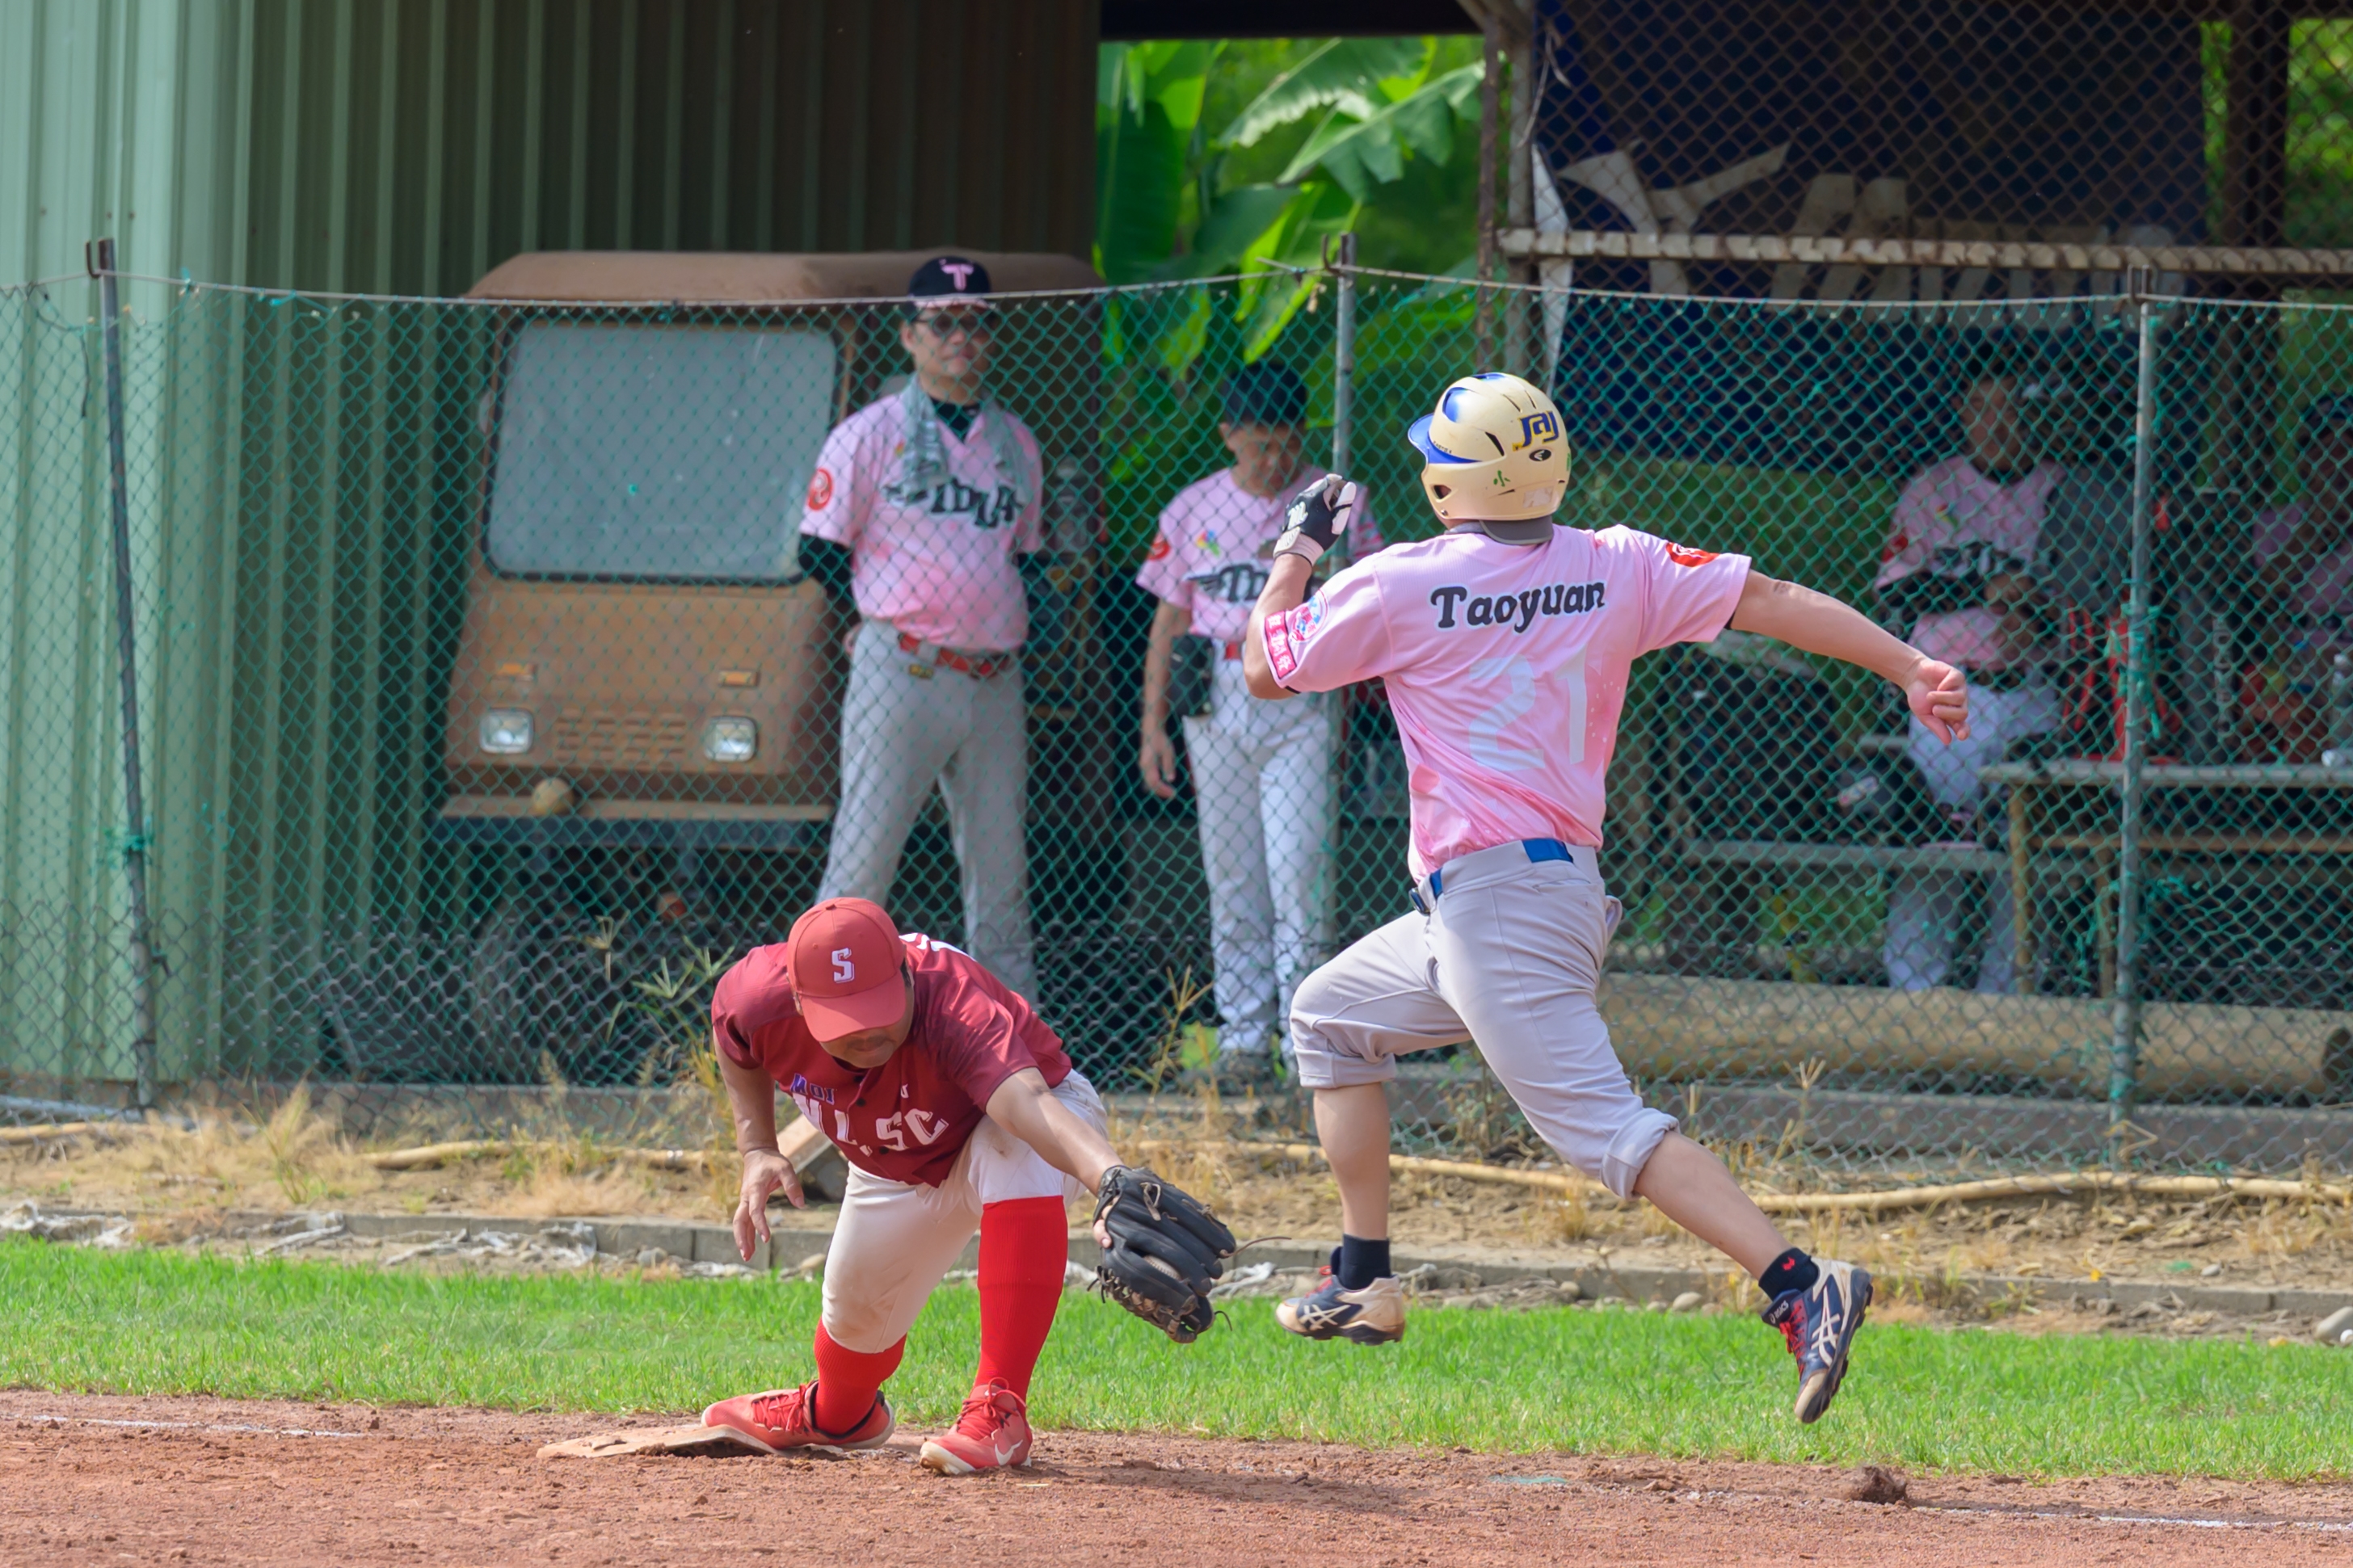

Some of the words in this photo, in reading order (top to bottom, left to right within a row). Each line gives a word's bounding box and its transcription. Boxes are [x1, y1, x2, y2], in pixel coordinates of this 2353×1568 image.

[1430, 582, 1605, 633] Taoyuan
[1469, 643, 1588, 771] 21
[831, 948, 855, 983] S
